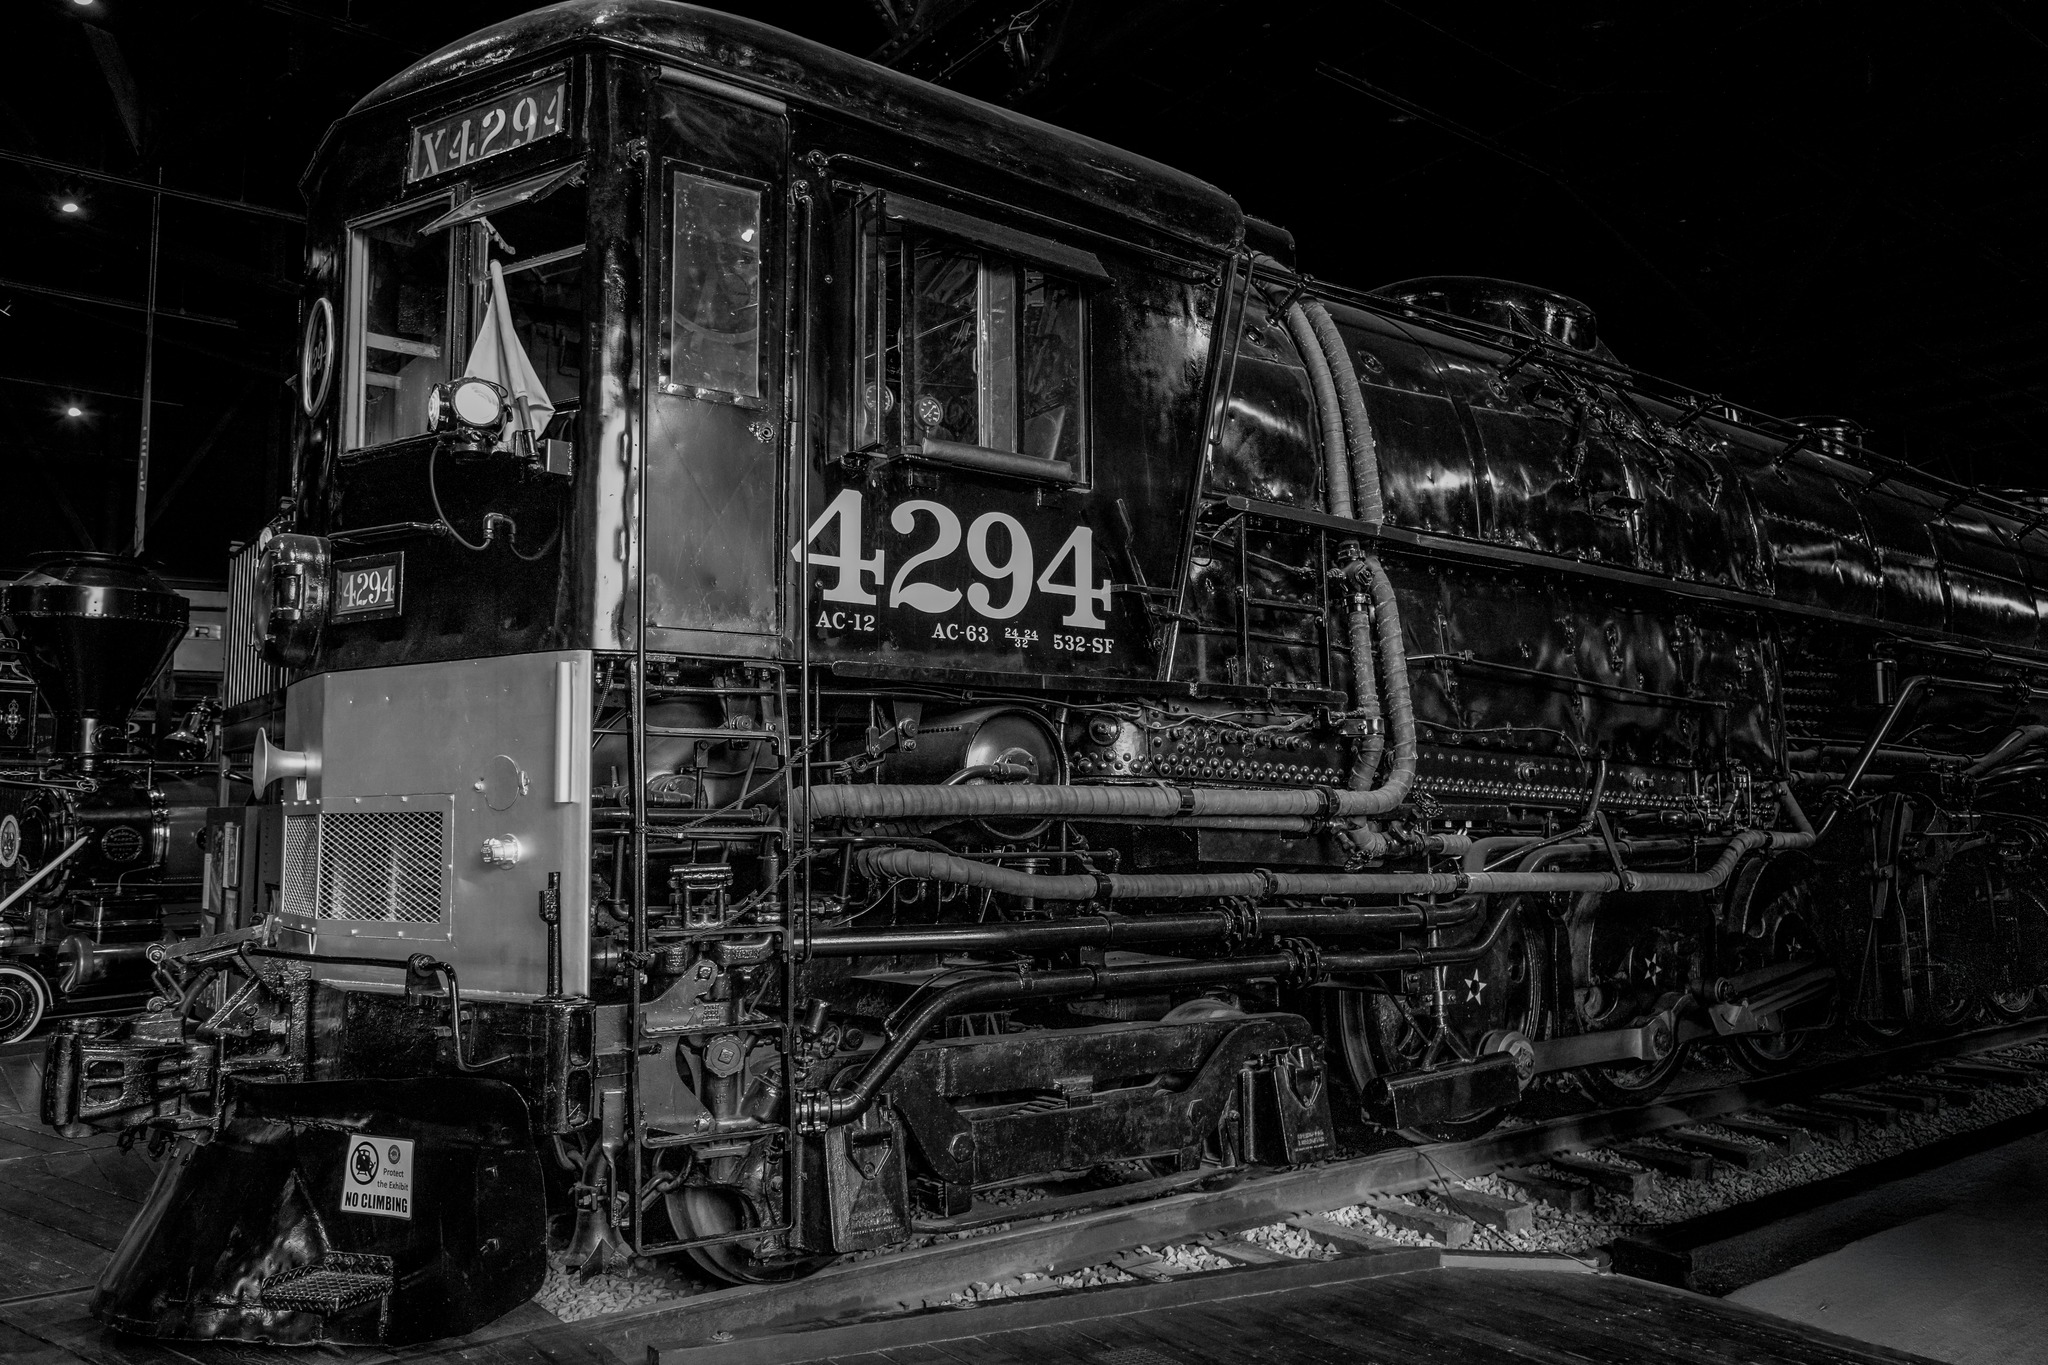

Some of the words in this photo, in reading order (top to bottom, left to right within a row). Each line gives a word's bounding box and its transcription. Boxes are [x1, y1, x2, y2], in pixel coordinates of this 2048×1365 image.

[791, 488, 1112, 630] 4294
[343, 568, 395, 607] 4294
[816, 610, 876, 632] AC-12
[931, 622, 989, 643] AC-63
[1004, 627, 1019, 638] 24
[1024, 629, 1039, 639] 24
[1053, 633, 1115, 654] 532-SF
[1014, 637, 1029, 649] 32
[383, 1167, 404, 1178] Protect
[377, 1180, 388, 1189] the
[388, 1181, 409, 1192] Exhibit
[344, 1191, 359, 1208] NO
[360, 1193, 408, 1214] CLIMBING
